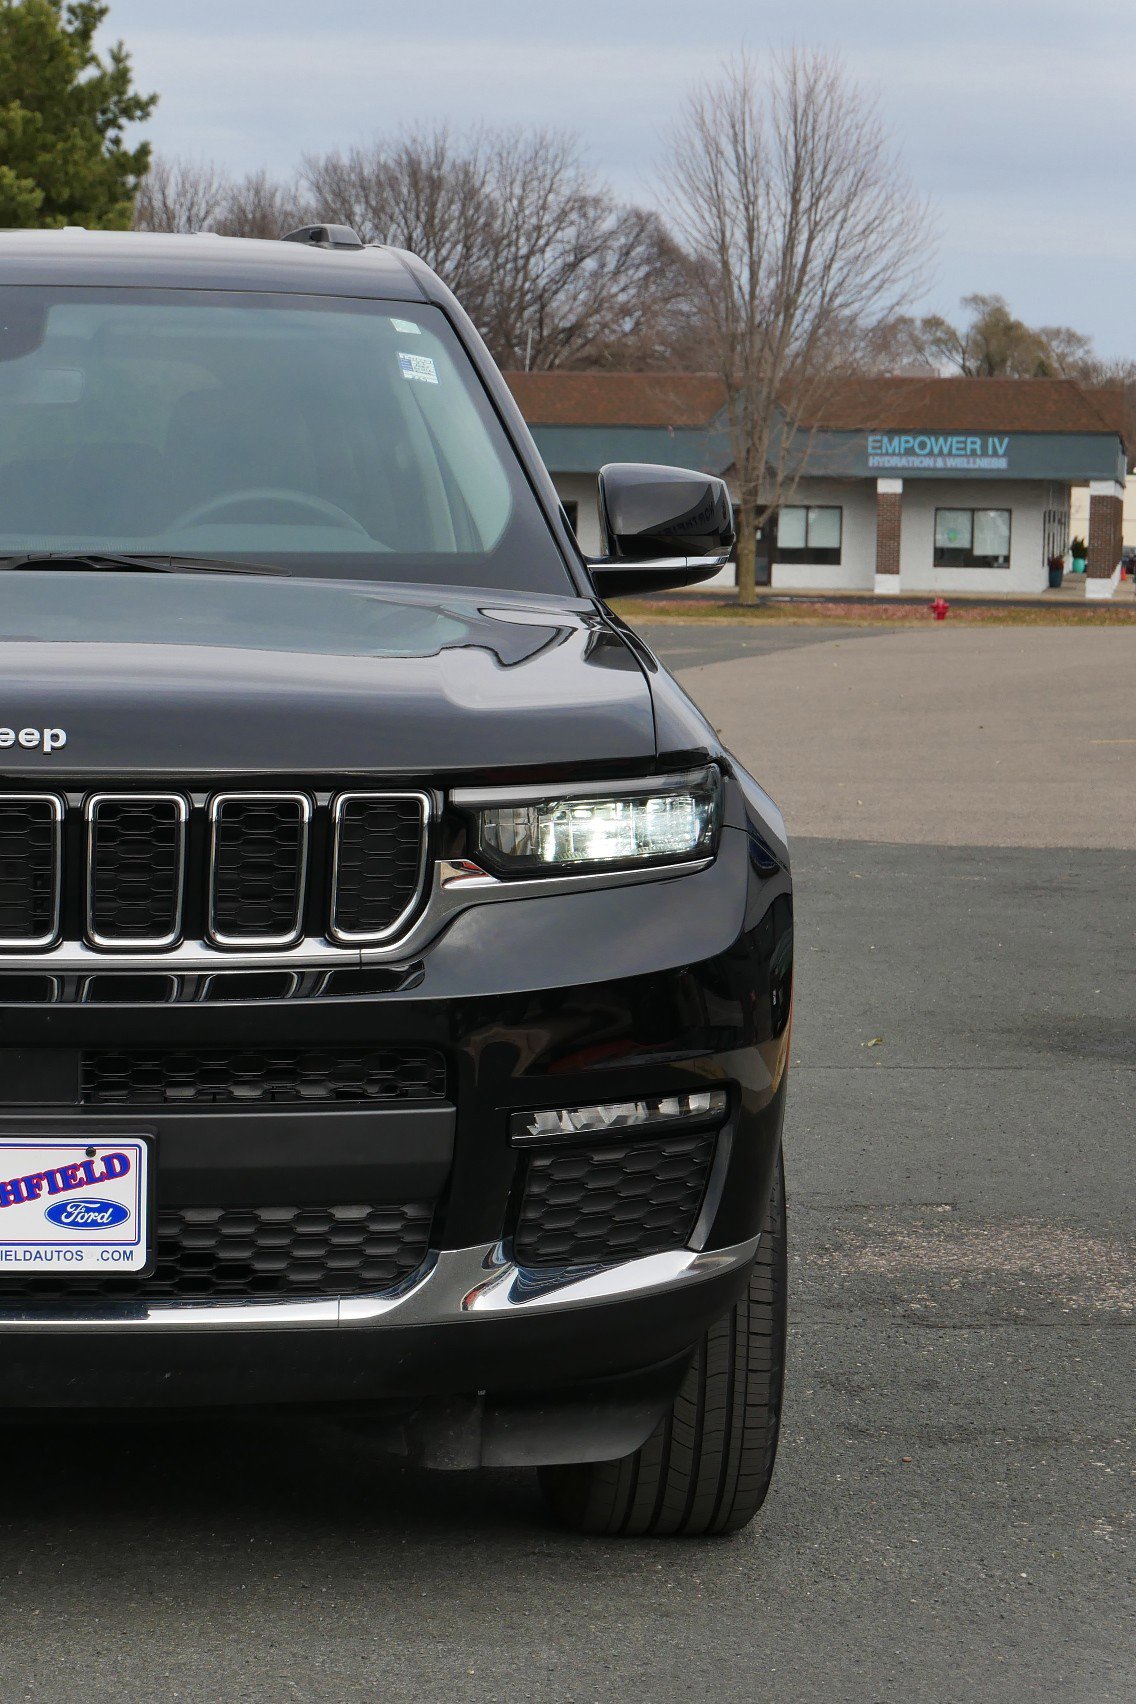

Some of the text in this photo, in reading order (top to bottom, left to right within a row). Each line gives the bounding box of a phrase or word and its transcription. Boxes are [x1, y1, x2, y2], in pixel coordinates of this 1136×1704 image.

[867, 435, 1010, 456] EMPOWER IV
[61, 1202, 113, 1224] Ford
[96, 1250, 134, 1262] .COM
